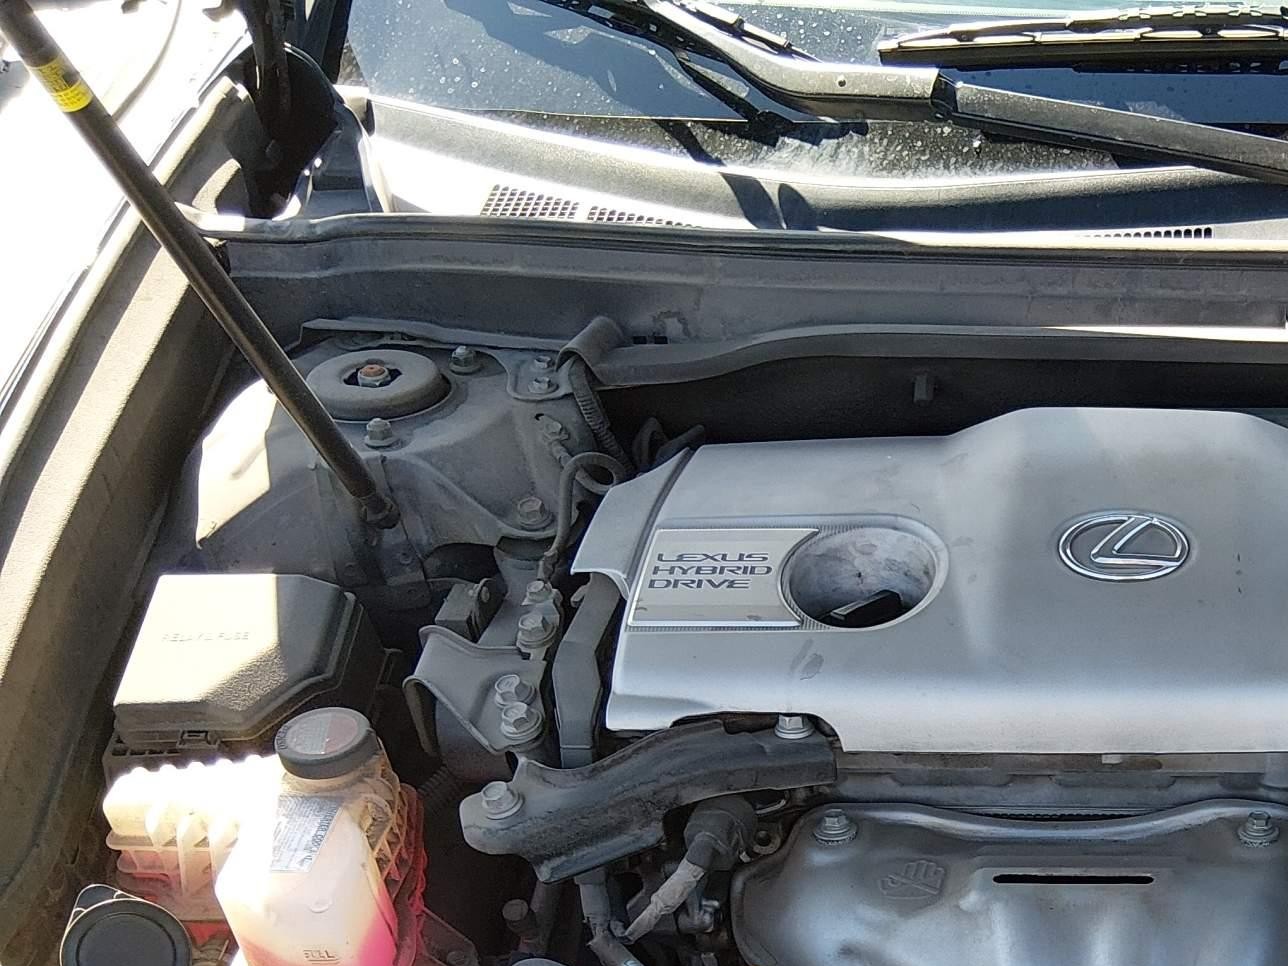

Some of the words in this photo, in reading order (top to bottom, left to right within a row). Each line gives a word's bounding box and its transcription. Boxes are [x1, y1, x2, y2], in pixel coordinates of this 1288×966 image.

[657, 553, 769, 563] LEXUS
[652, 565, 773, 576] HYBRID
[648, 579, 752, 589] DRIVE
